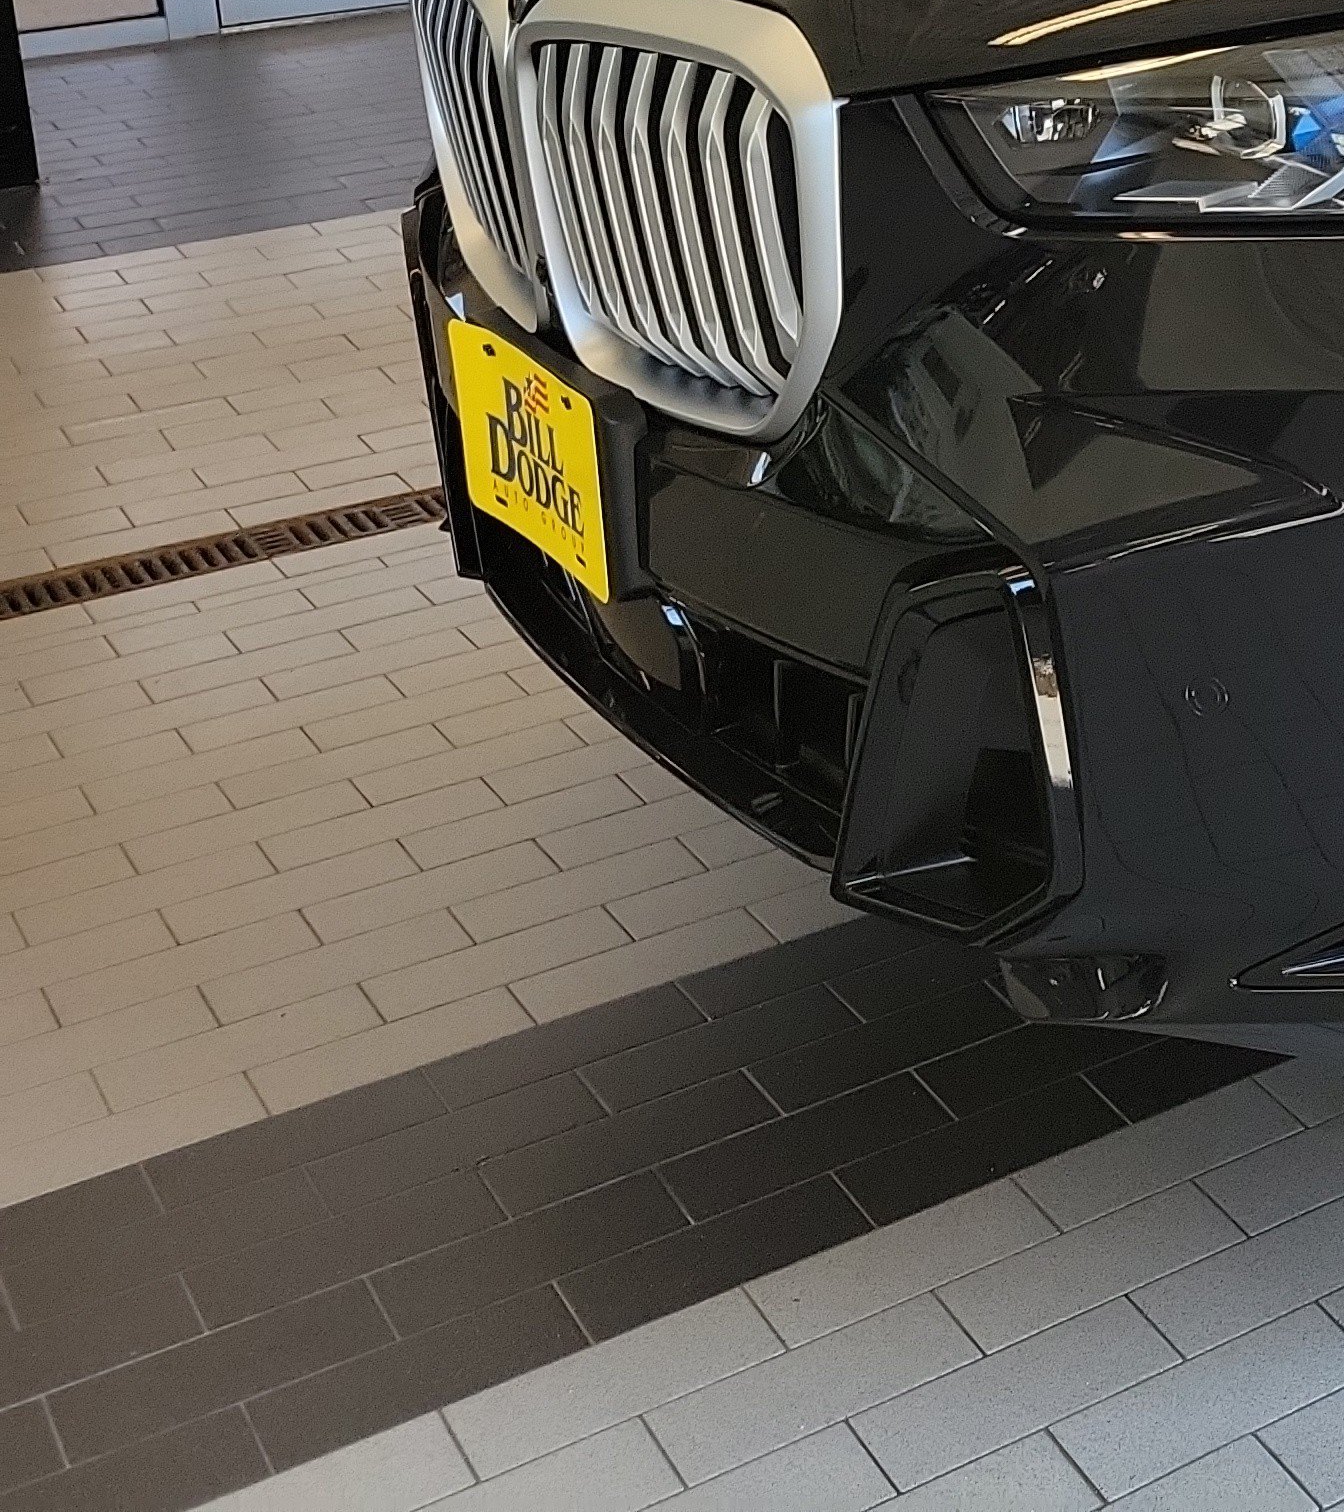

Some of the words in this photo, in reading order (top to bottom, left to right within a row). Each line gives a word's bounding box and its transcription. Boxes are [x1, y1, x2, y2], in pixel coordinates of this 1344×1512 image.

[487, 411, 585, 538] DODGE
[502, 376, 564, 476] BILL
[493, 478, 529, 512] AUTO
[541, 510, 585, 555] GROUP
